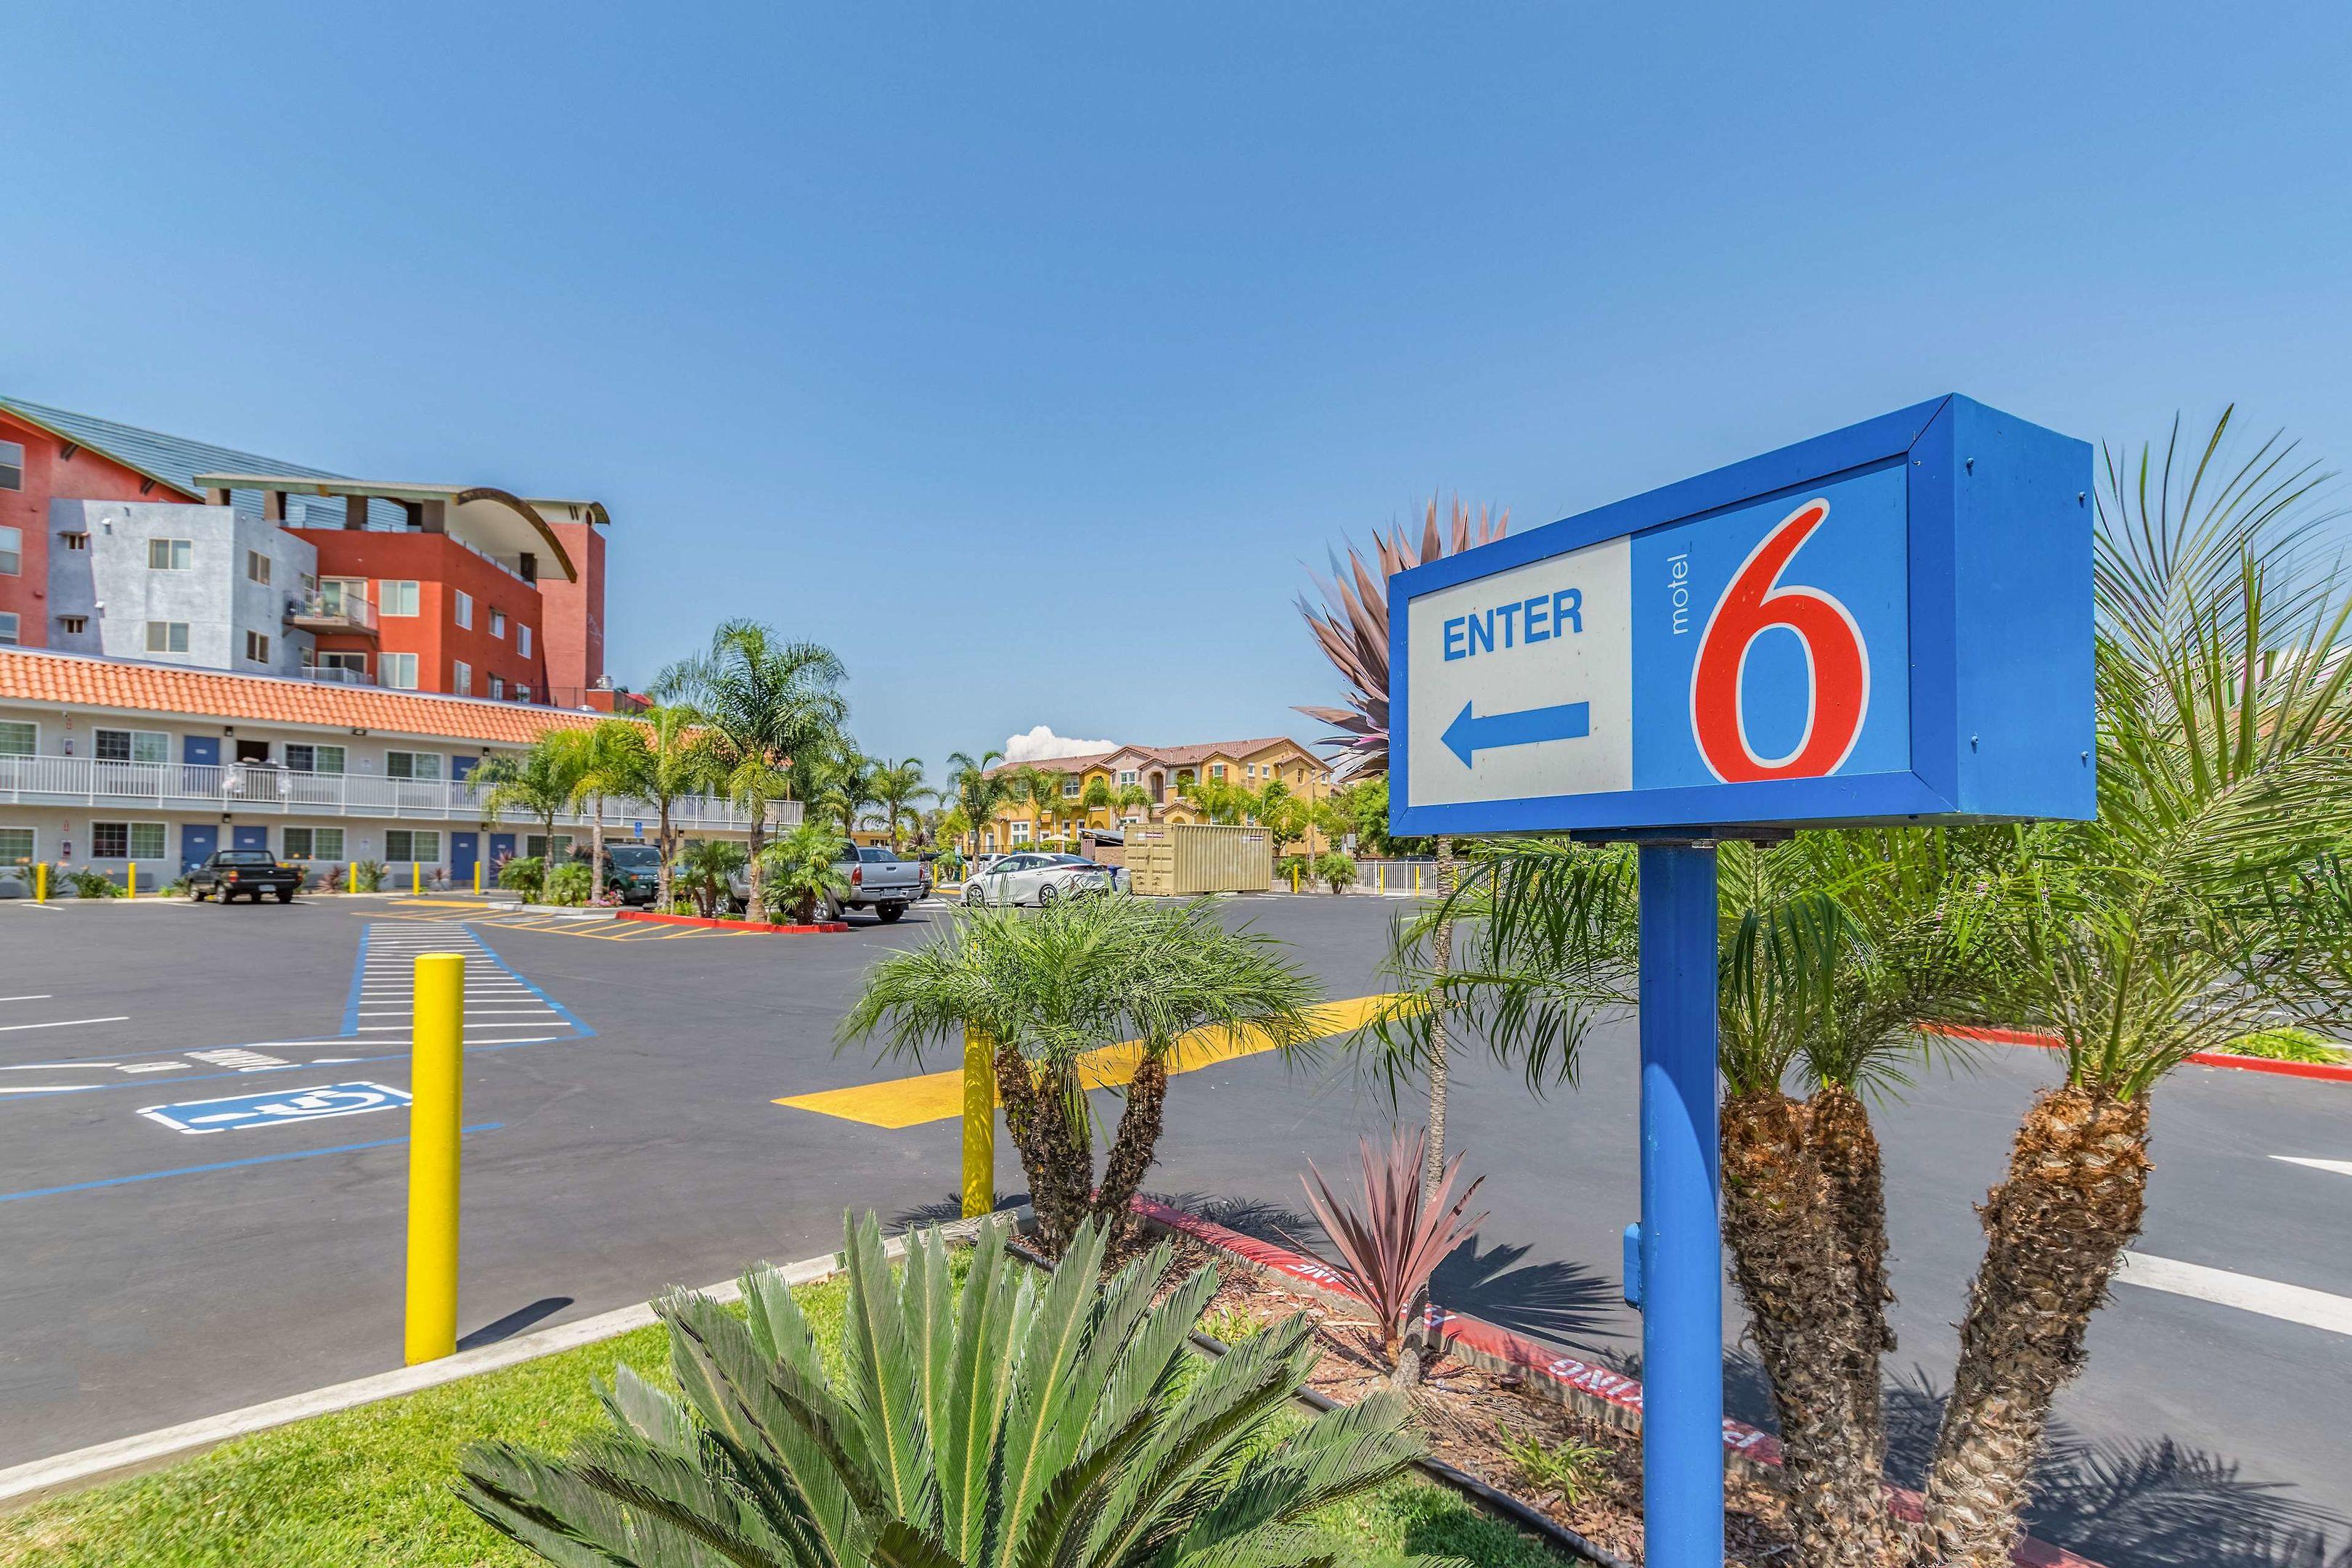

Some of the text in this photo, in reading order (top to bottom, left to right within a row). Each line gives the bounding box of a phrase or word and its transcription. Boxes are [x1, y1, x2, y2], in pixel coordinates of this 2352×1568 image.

[1444, 588, 1583, 661] ENTER
[1667, 553, 1689, 634] motel
[1689, 497, 1871, 783] 6
